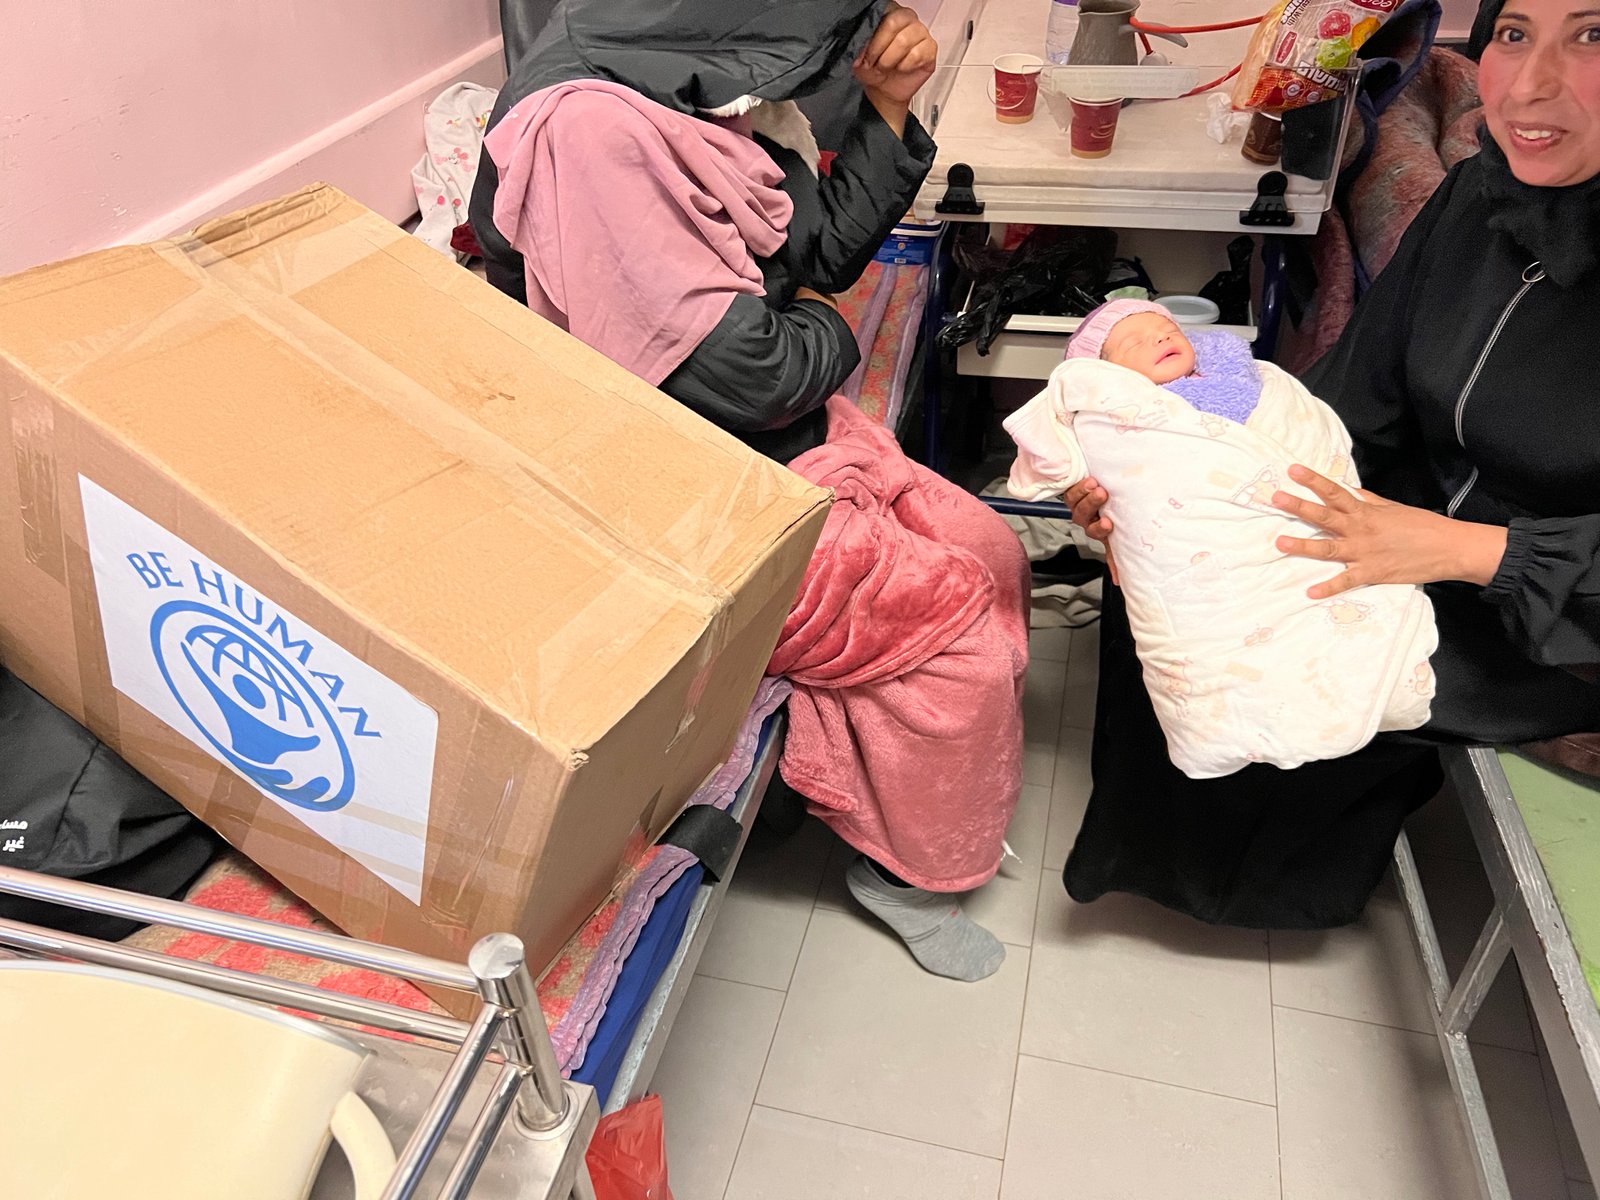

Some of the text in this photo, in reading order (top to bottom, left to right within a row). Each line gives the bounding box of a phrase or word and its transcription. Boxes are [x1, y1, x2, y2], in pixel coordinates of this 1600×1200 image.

[126, 551, 382, 738] BE HUMAN
[2, 836, 25, 852] غير
